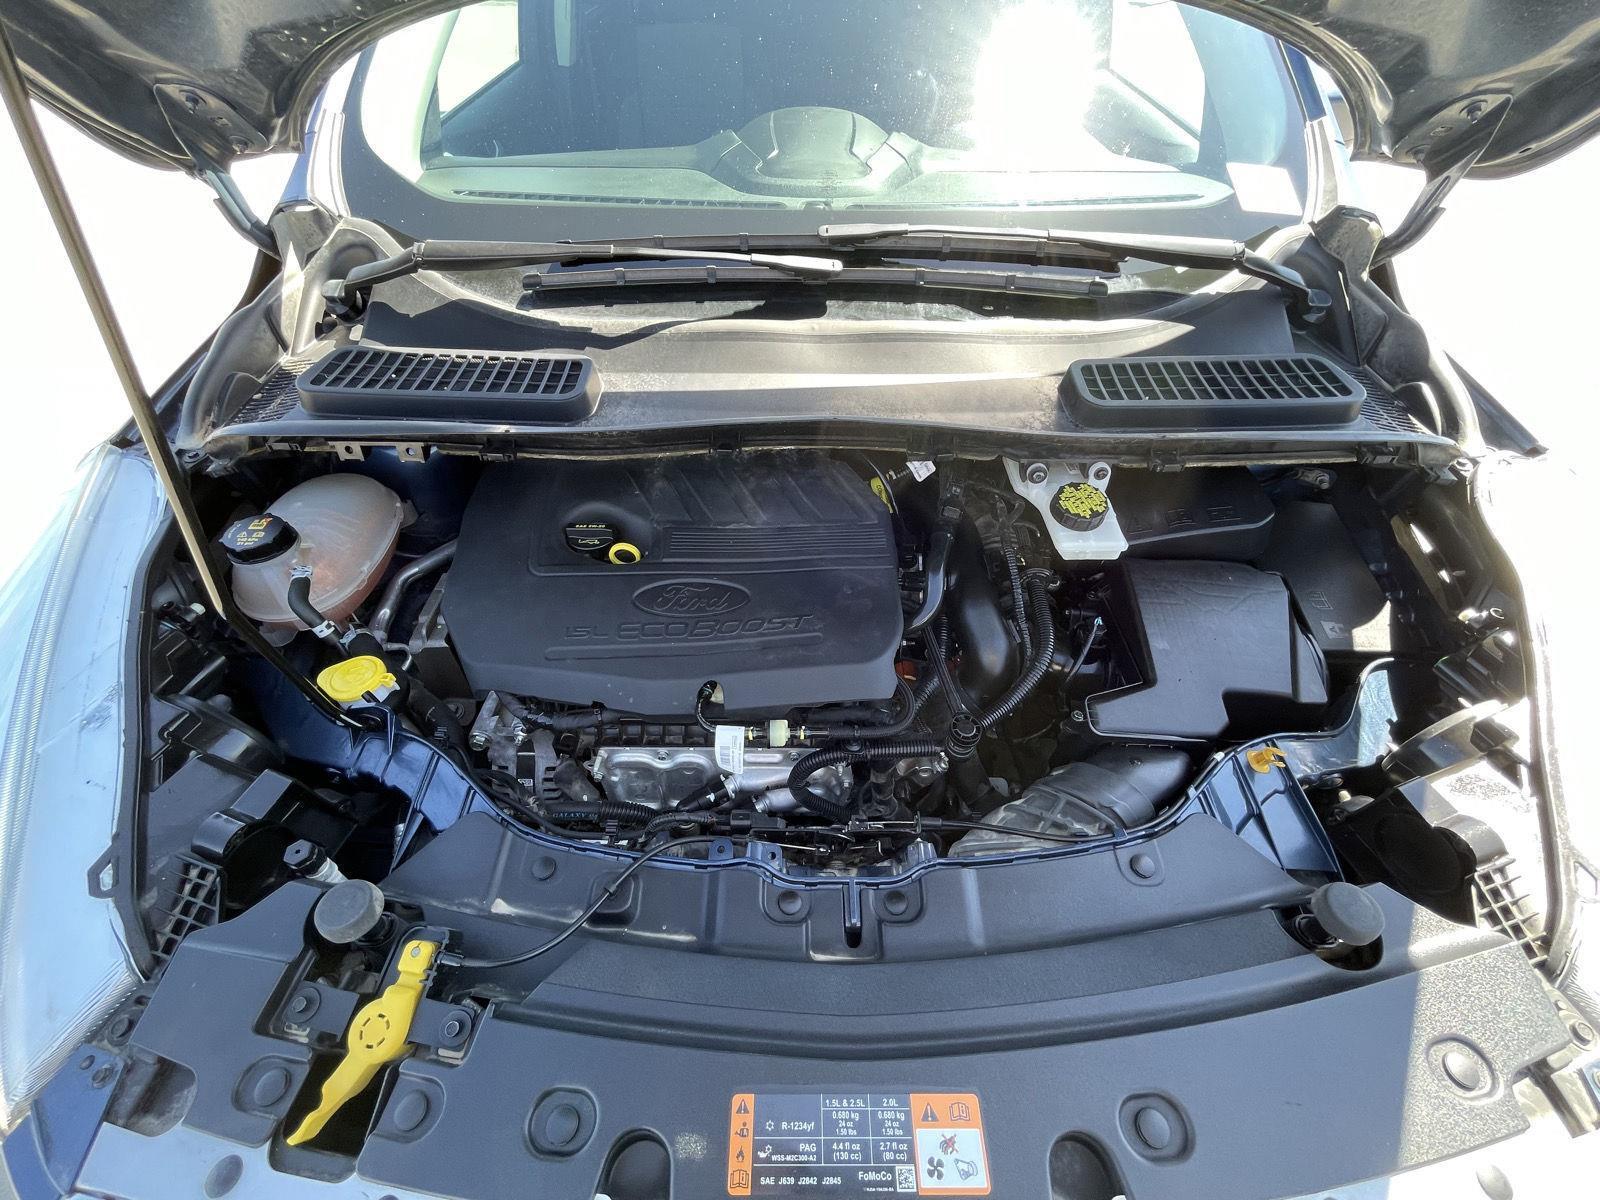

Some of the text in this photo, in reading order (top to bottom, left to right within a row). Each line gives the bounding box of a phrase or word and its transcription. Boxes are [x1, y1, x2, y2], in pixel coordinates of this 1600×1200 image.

[647, 584, 736, 612] Ford
[617, 614, 816, 641] ECOBOOST
[826, 1098, 866, 1107] 1.5L & 2.5L
[882, 1098, 899, 1107] 2.0L
[832, 1110, 860, 1121] 0.680 kg
[877, 1110, 905, 1121] 0.680 kg
[781, 1121, 815, 1132] R-1234yf
[835, 1128, 857, 1136] 1.50 lbs
[882, 1128, 904, 1136] 1.50 lbs
[799, 1143, 817, 1152] PAG
[832, 1142, 844, 1150] 4.4
[845, 1142, 850, 1150] fl
[880, 1142, 891, 1150] 2.7
[892, 1142, 898, 1150] fl
[833, 1151, 862, 1162] (130 cc)
[883, 1151, 908, 1162] (80 cc)
[760, 1176, 842, 1185] SAE J639 J2842 J2845
[858, 1171, 893, 1181] FoMoCo
